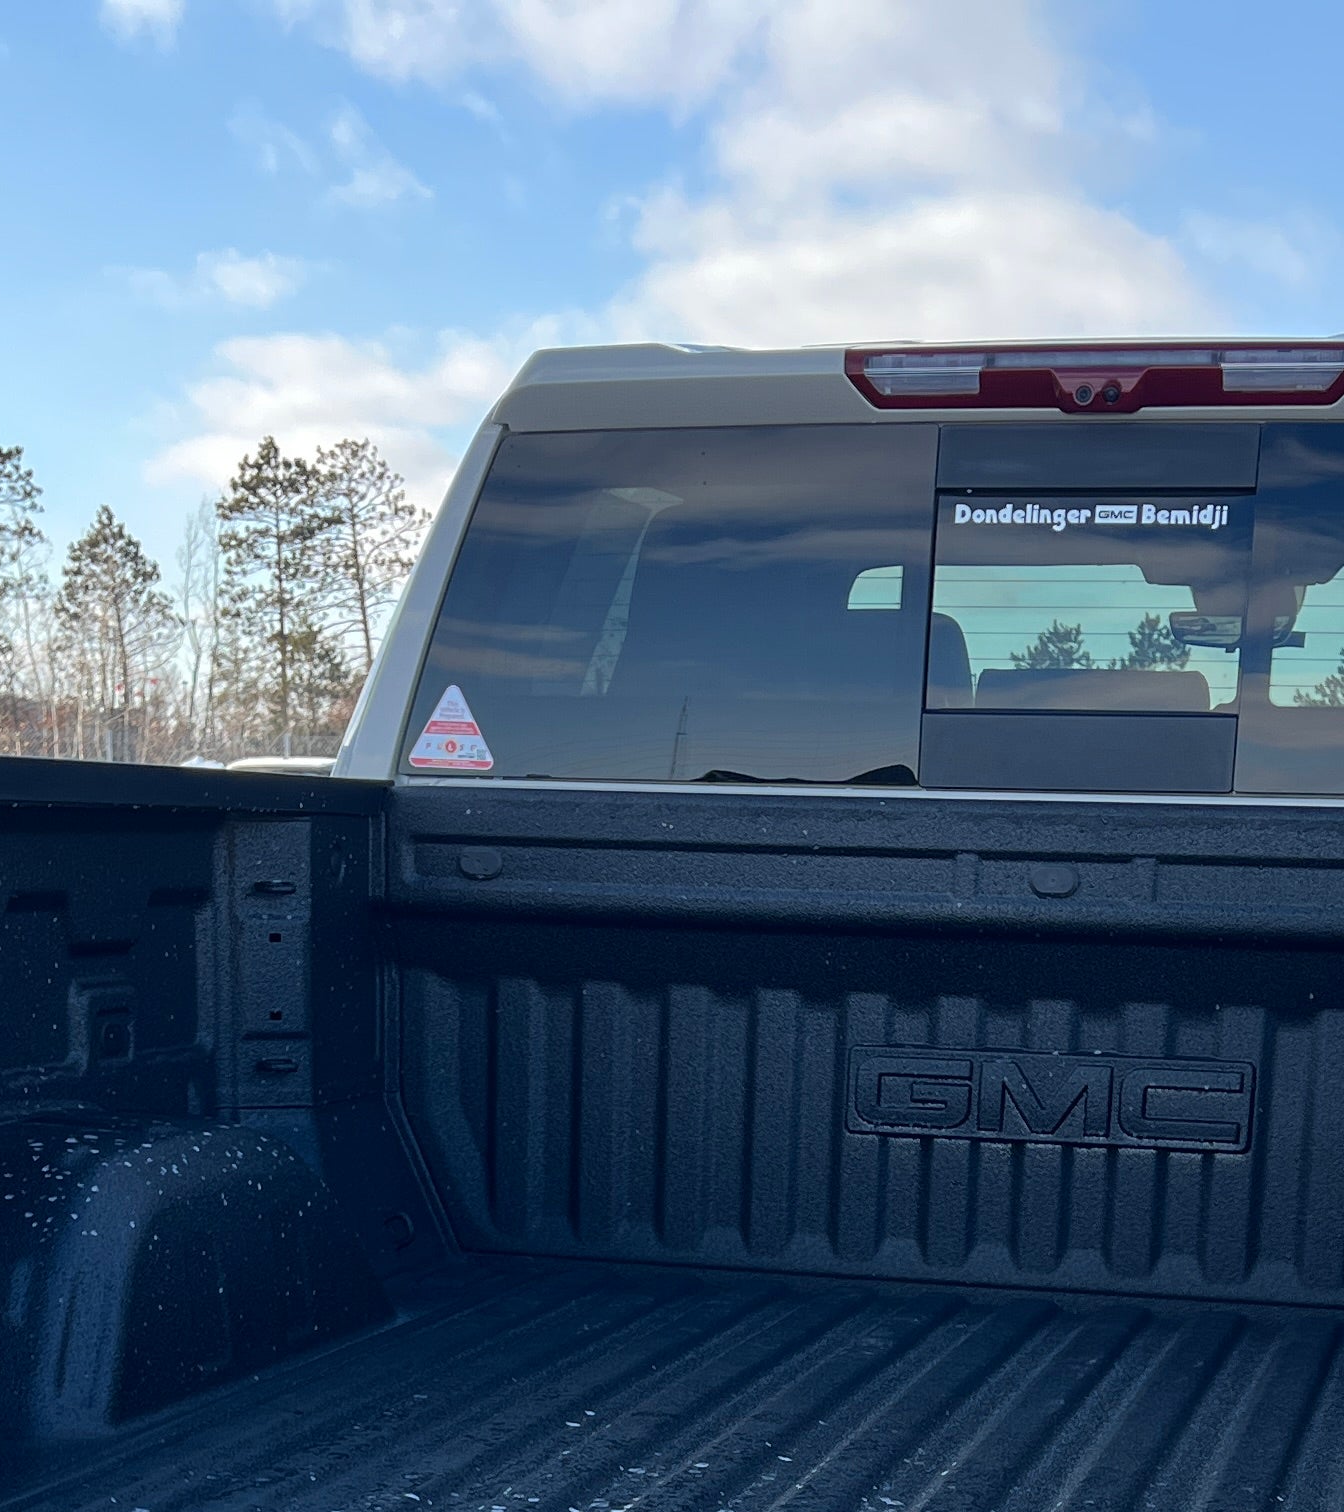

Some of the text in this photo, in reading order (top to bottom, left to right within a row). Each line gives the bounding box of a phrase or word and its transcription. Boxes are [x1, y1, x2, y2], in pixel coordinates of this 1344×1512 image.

[954, 503, 1229, 531] Dondelinger GMC Bemidji
[856, 1054, 1246, 1145] GMC
